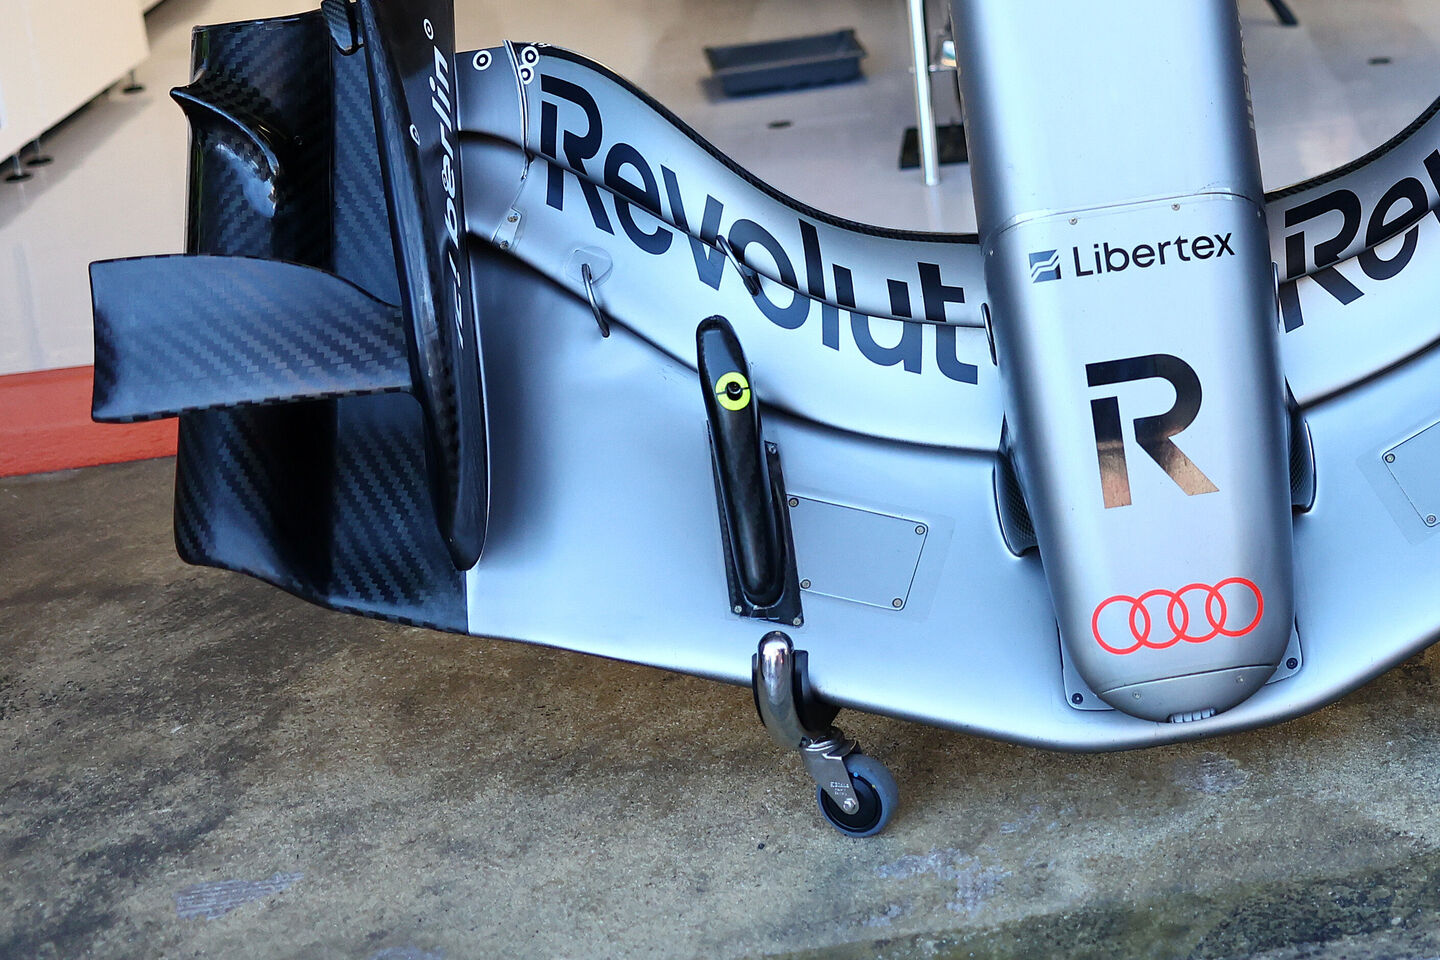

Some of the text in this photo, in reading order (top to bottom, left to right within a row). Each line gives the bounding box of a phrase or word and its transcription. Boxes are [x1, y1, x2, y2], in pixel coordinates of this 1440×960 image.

[428, 45, 460, 250] berlin
[541, 74, 978, 384] Revolut
[1073, 233, 1236, 277] Libertex
